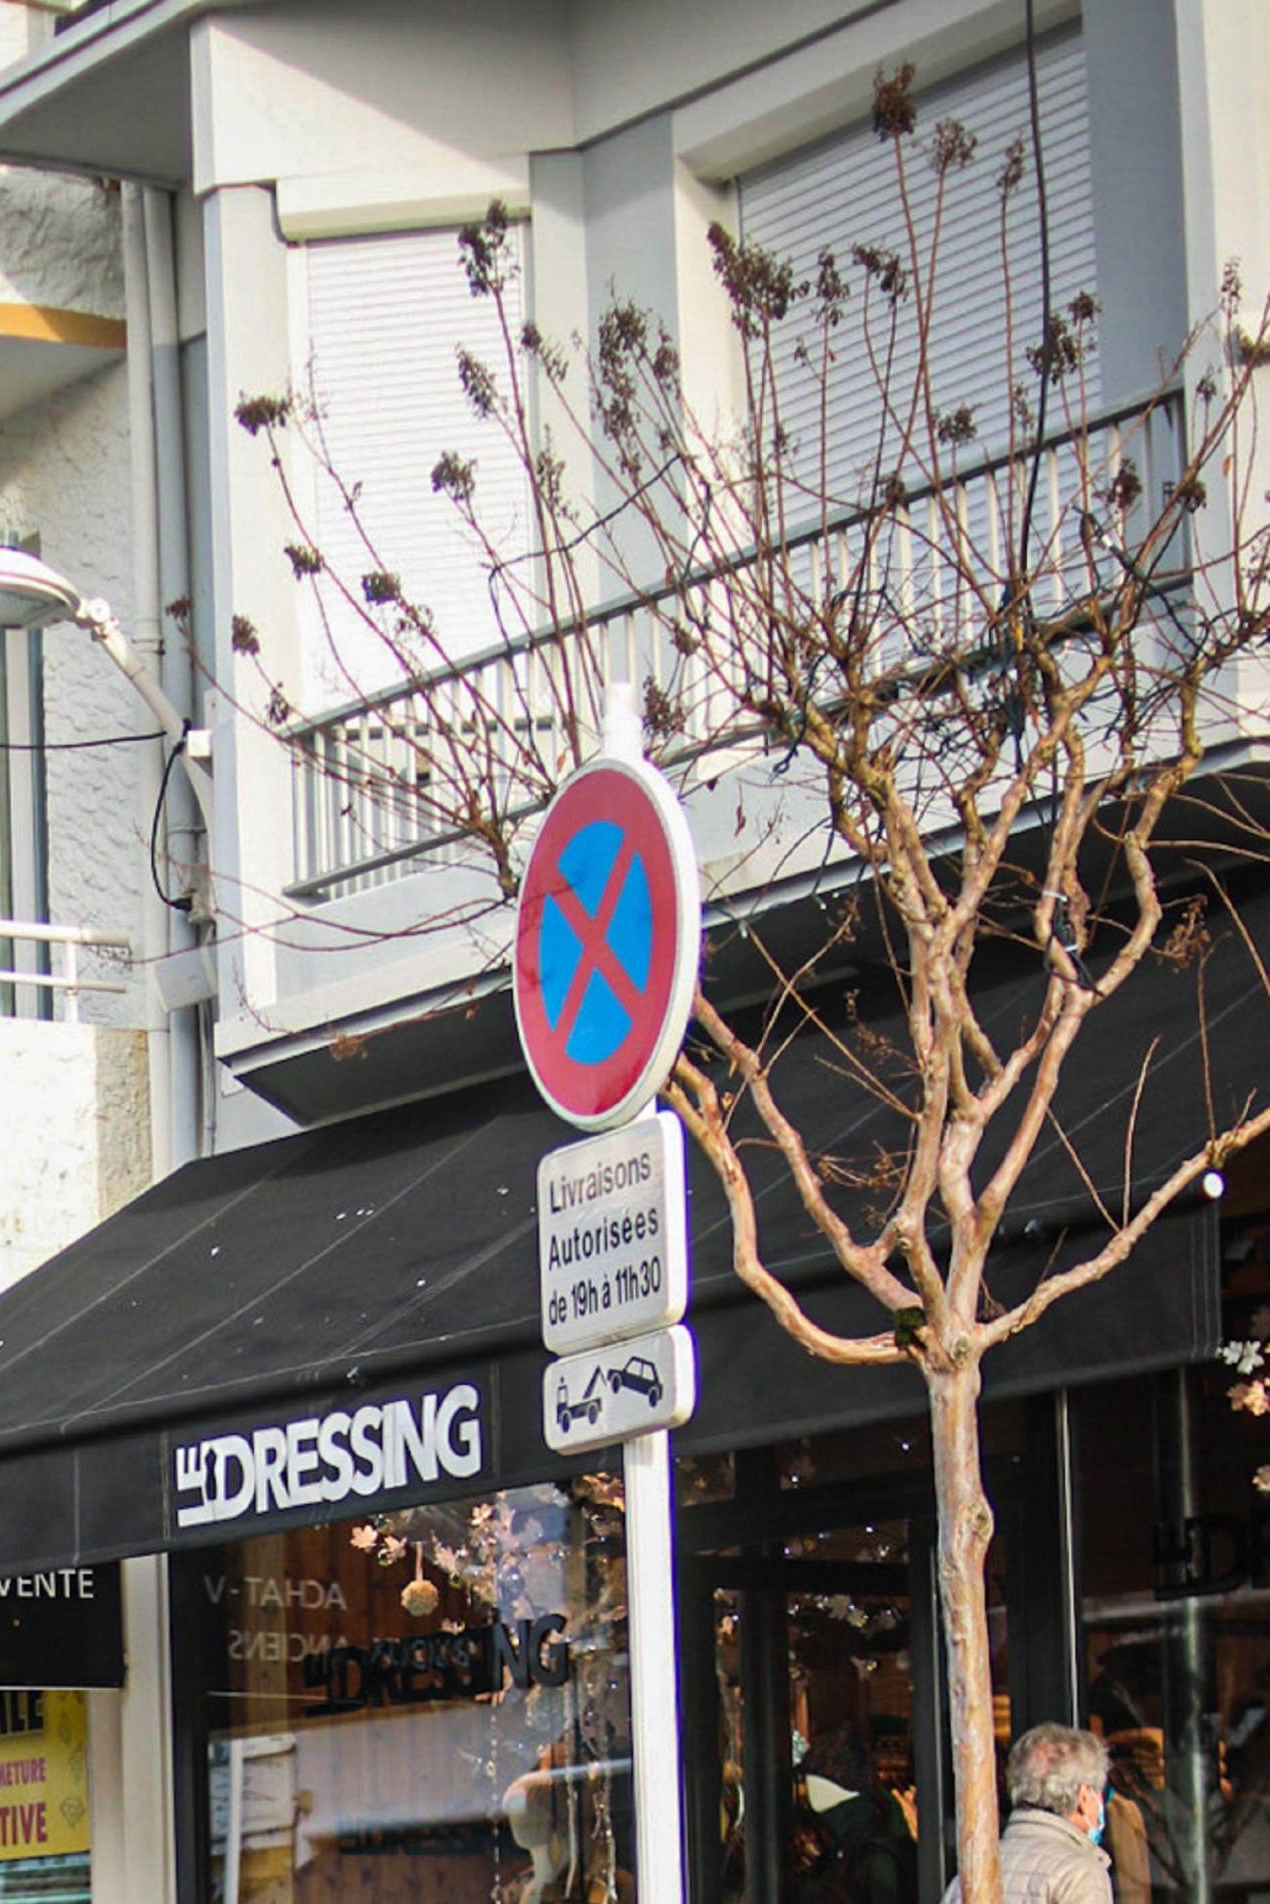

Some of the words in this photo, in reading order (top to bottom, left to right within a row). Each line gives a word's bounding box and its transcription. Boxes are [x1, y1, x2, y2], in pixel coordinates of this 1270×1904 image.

[550, 1152, 652, 1214] Livraisons
[549, 1207, 659, 1271] Autorisées
[549, 1289, 567, 1326] de
[572, 1276, 598, 1317] 19h
[602, 1269, 612, 1309] à
[615, 1256, 662, 1303] 11h30
[209, 1384, 481, 1520] DRESSING
